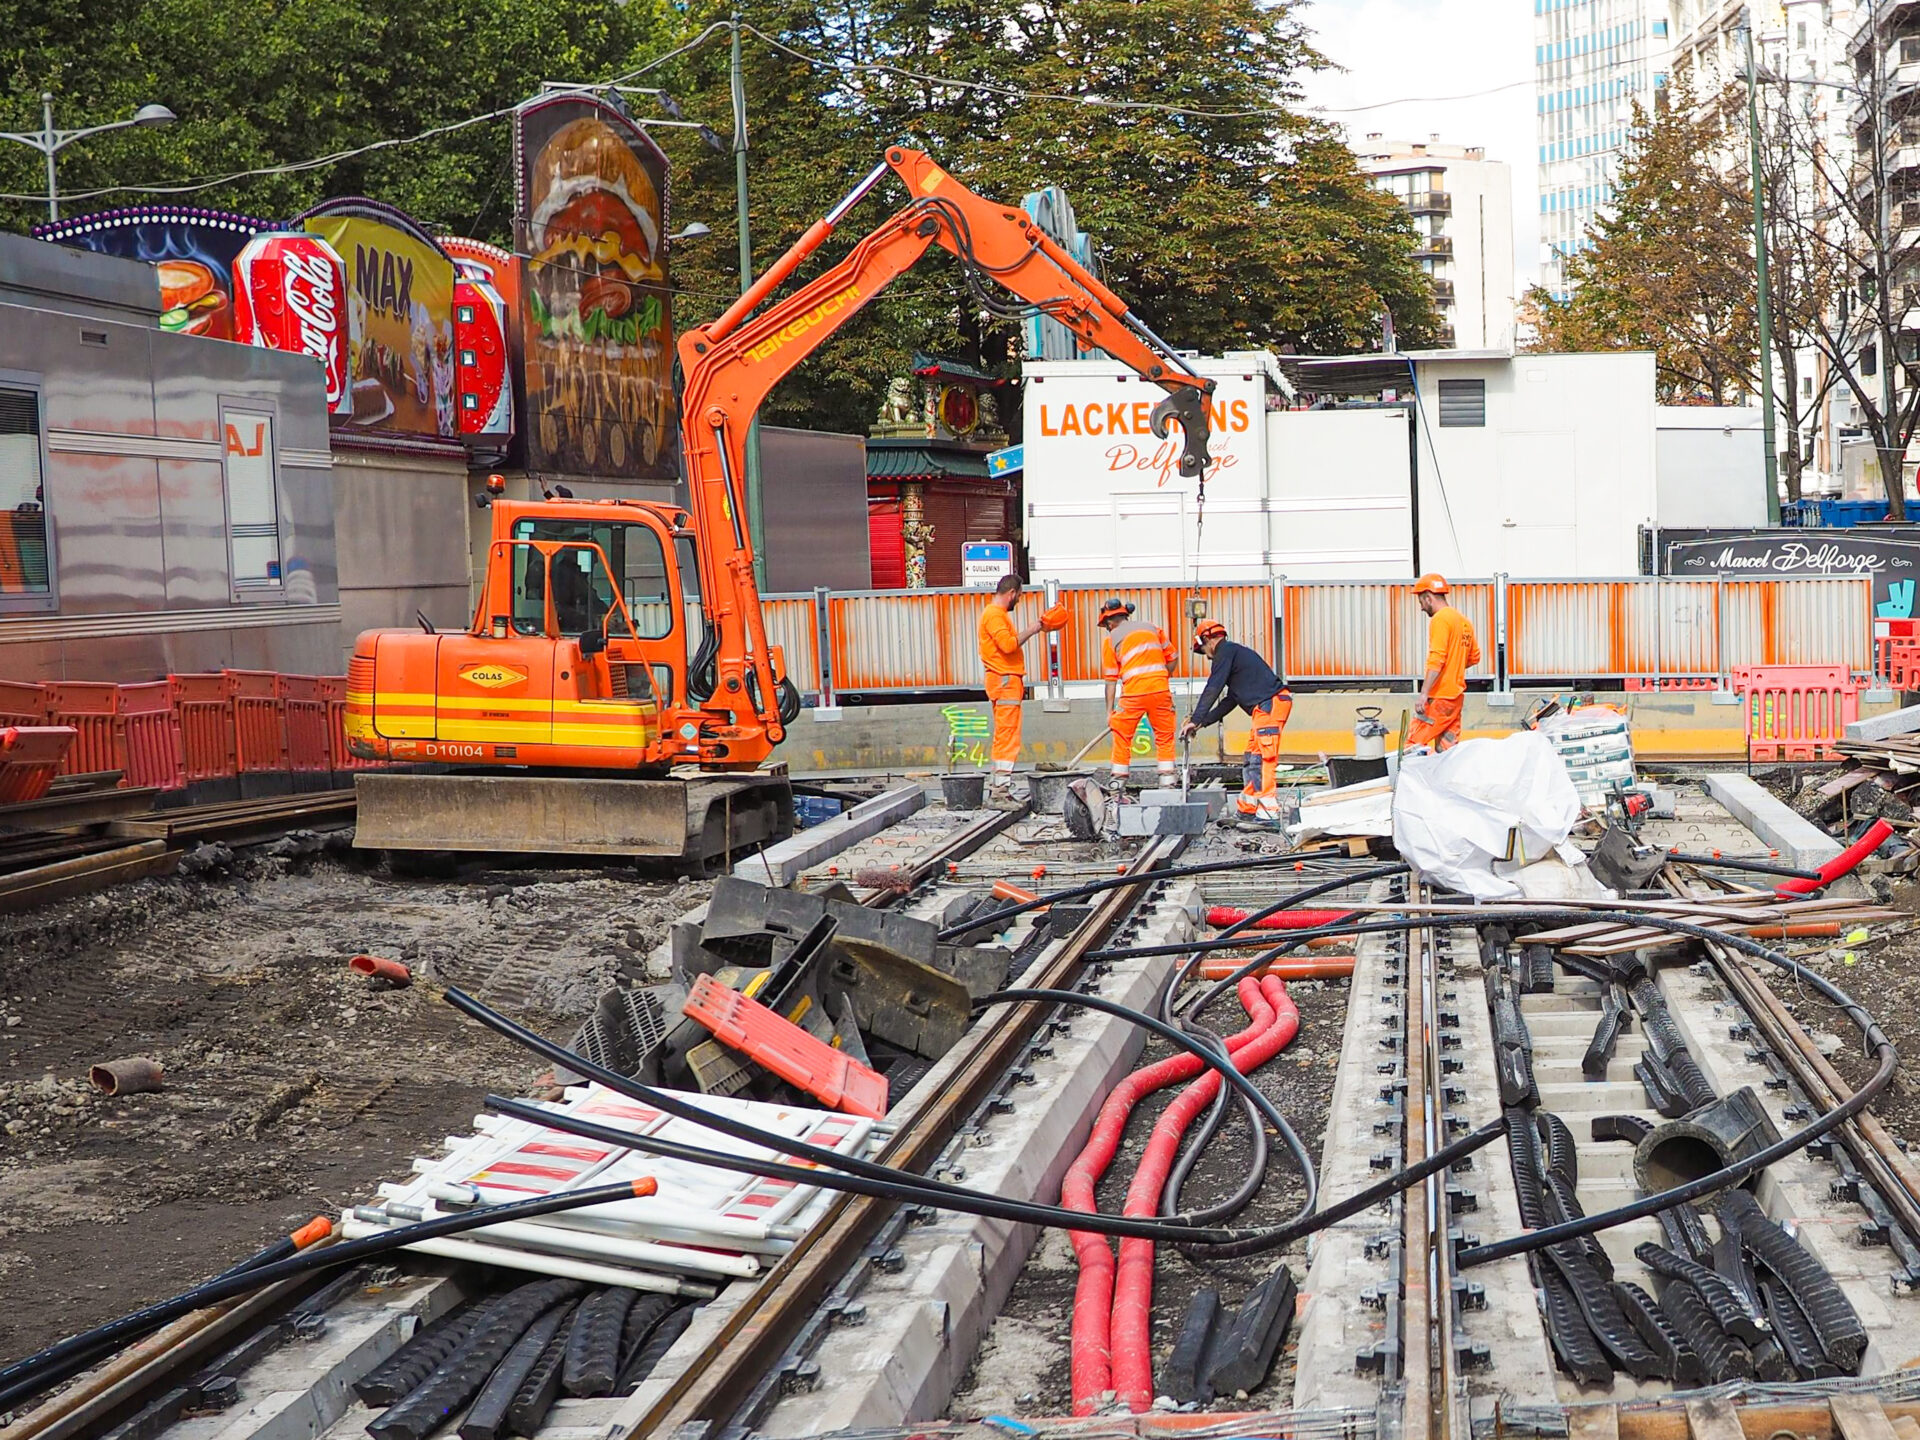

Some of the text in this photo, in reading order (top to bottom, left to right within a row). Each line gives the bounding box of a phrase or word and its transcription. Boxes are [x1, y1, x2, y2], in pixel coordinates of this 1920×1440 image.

[356, 243, 413, 318] MAX
[1040, 400, 1249, 436] LACKENS
[1105, 442, 1239, 487] Delfge
[1709, 543, 1886, 574] Marcel Delforge
[472, 672, 502, 680] COLAS
